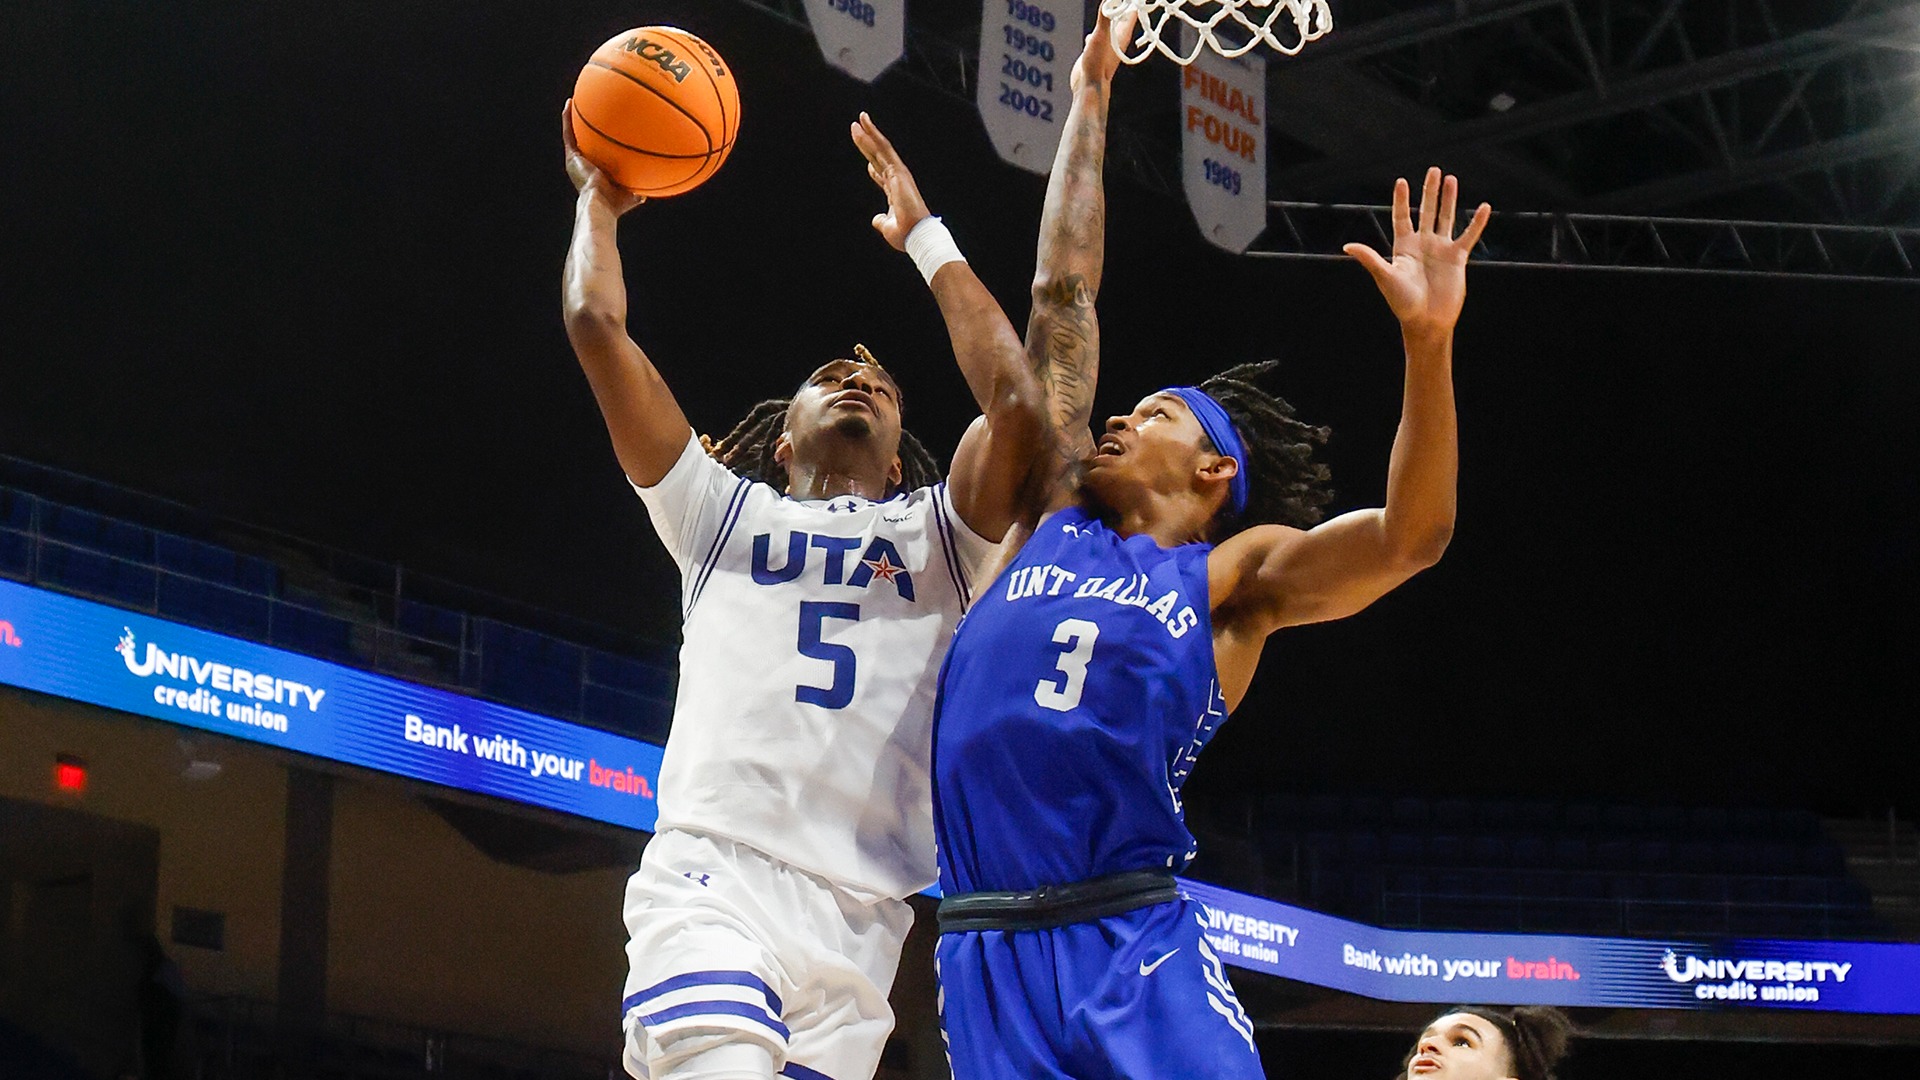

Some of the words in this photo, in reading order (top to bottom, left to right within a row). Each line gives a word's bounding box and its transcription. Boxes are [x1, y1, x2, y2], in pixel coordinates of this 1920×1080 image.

[1006, 0, 1056, 33] 1989
[619, 37, 693, 84] NCAA
[1003, 24, 1055, 63] 1990
[1001, 53, 1053, 93] 2001
[1182, 63, 1260, 126] FINAL
[999, 81, 1054, 123] 2002
[1186, 104, 1256, 164] FOUR
[1203, 157, 1242, 196] 1989
[751, 530, 916, 602] UTA
[1006, 564, 1077, 602] UNT
[1073, 573, 1199, 639] DALLAS
[118, 642, 325, 712] UNIVERSITY
[795, 600, 860, 710] 5
[1034, 618, 1100, 712] 3
[153, 685, 221, 717] credit
[226, 702, 288, 733] union
[404, 714, 468, 754] Bank
[473, 735, 527, 768] with
[530, 750, 585, 777] your
[590, 758, 653, 799] brain.
[1241, 942, 1279, 964] union
[1343, 943, 1382, 973] Bank
[1384, 953, 1438, 977] with
[1442, 959, 1501, 982] your
[1506, 955, 1580, 981] brain.
[1664, 954, 1852, 983] UNIVERSITY
[1695, 981, 1757, 1000] credit
[1760, 982, 1819, 1002] union
